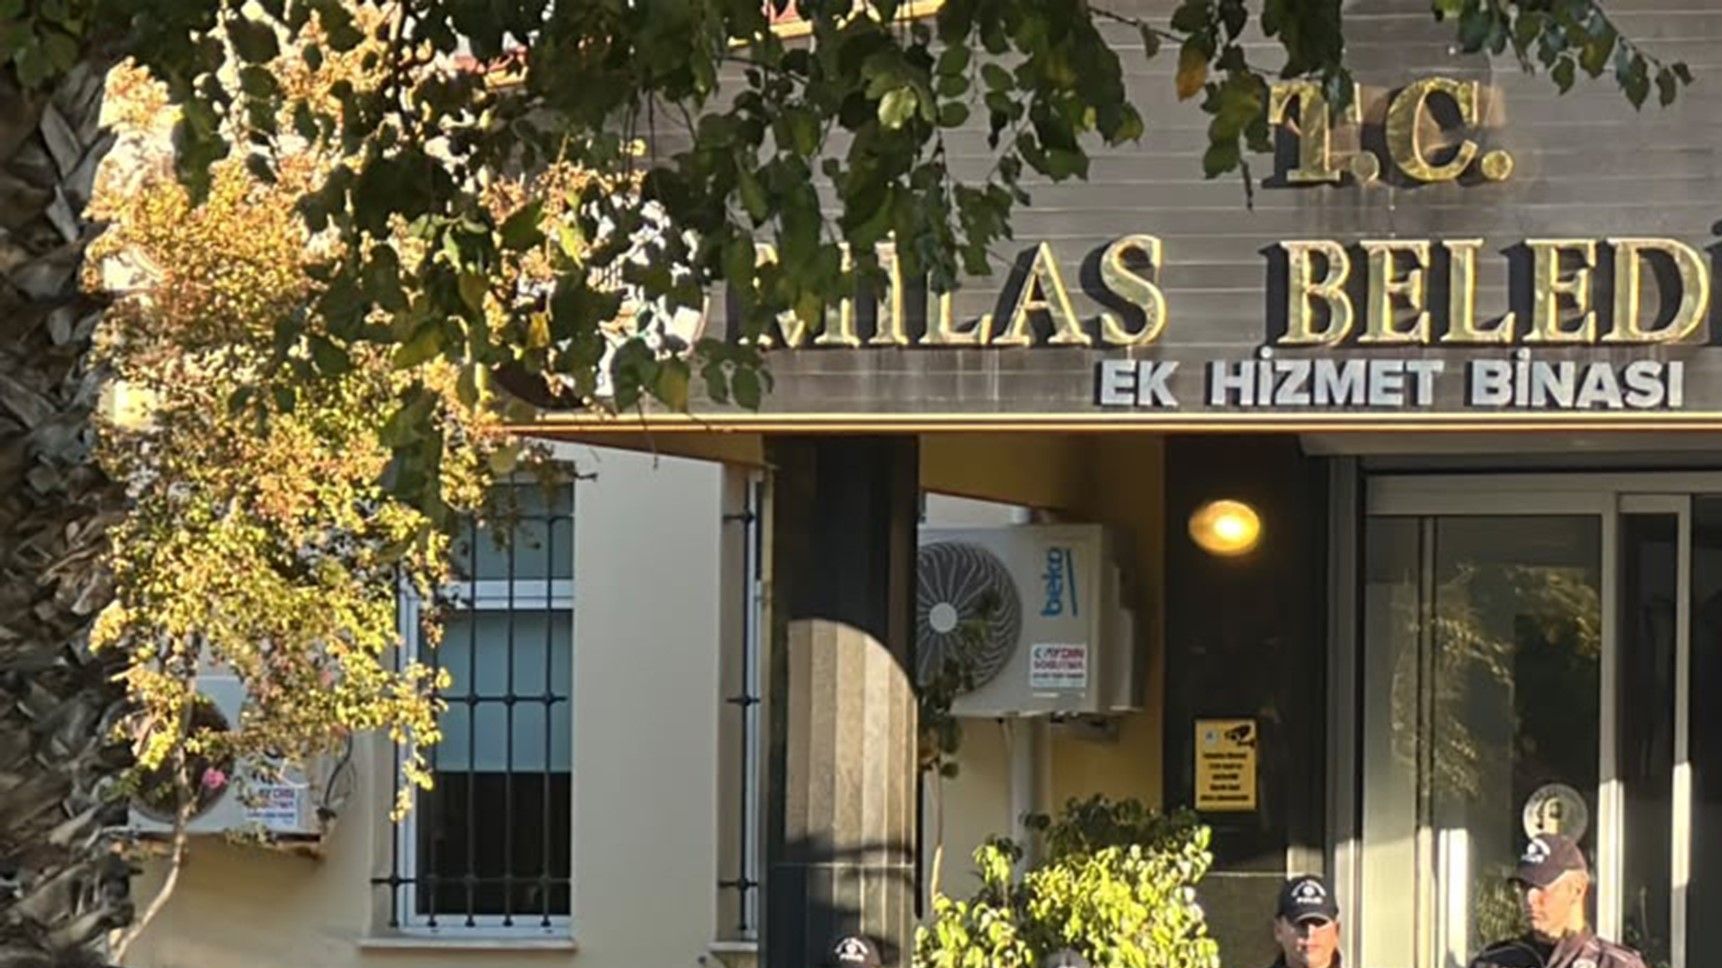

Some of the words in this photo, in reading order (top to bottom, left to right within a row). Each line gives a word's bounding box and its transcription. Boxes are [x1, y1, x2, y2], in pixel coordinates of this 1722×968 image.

[1268, 77, 1513, 181] T.C.
[1101, 359, 1180, 407] EK
[1211, 347, 1445, 406] HİZMET
[1472, 348, 1685, 408] BİNASI
[1040, 546, 1063, 617] beko
